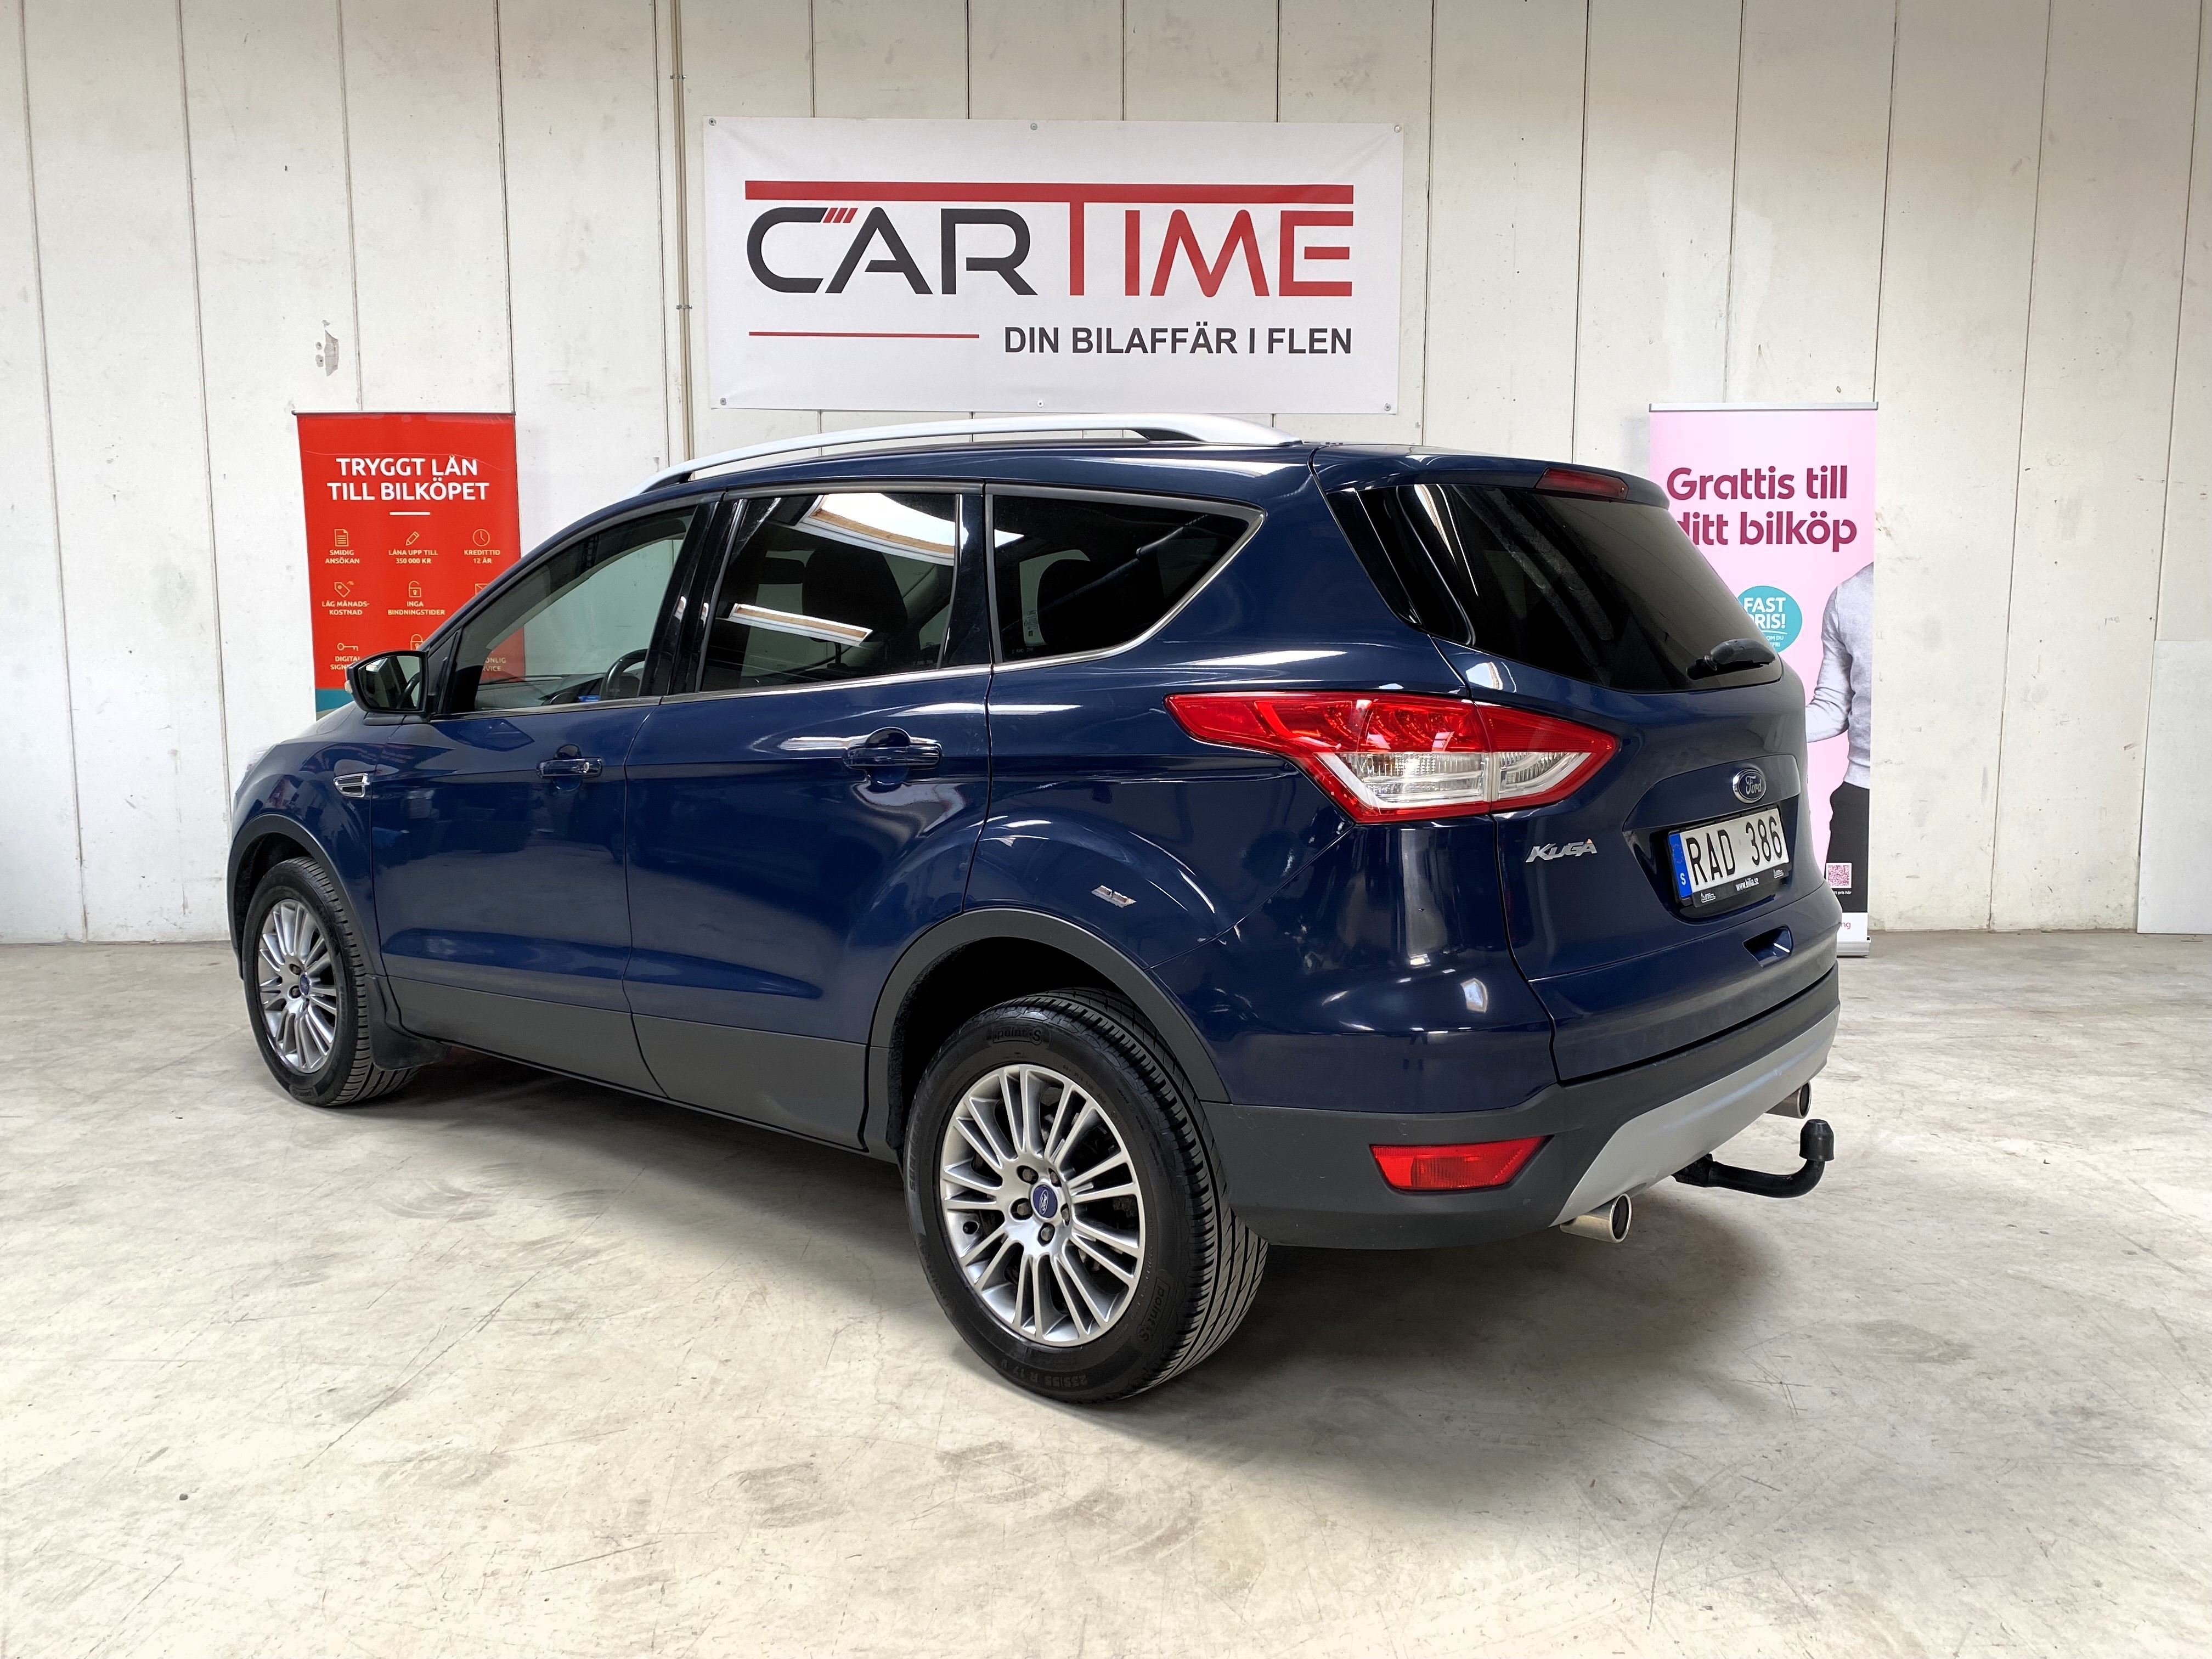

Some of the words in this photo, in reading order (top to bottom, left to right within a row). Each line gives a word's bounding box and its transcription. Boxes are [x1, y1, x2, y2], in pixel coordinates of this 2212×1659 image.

[746, 180, 1354, 298] CARTIME
[1005, 327, 1059, 353] DIN
[1072, 321, 1238, 354] BILAFFÄR
[1249, 328, 1255, 354] I
[1267, 328, 1351, 354] FLEN
[336, 458, 426, 476] TRYGGT
[432, 455, 477, 476] LÅN
[327, 482, 375, 500] TILL
[380, 477, 489, 500] BILKÖPET
[1667, 465, 1795, 500] Grattis
[1807, 465, 1848, 499] till
[1740, 510, 1858, 552] bilköp
[1743, 597, 1786, 613] FAST
[1745, 775, 1762, 795] Ford
[1525, 838, 1598, 862] KUGA
[1685, 829, 1736, 885] RAD
[1746, 816, 1782, 866] 386
[1680, 873, 1686, 885] S
